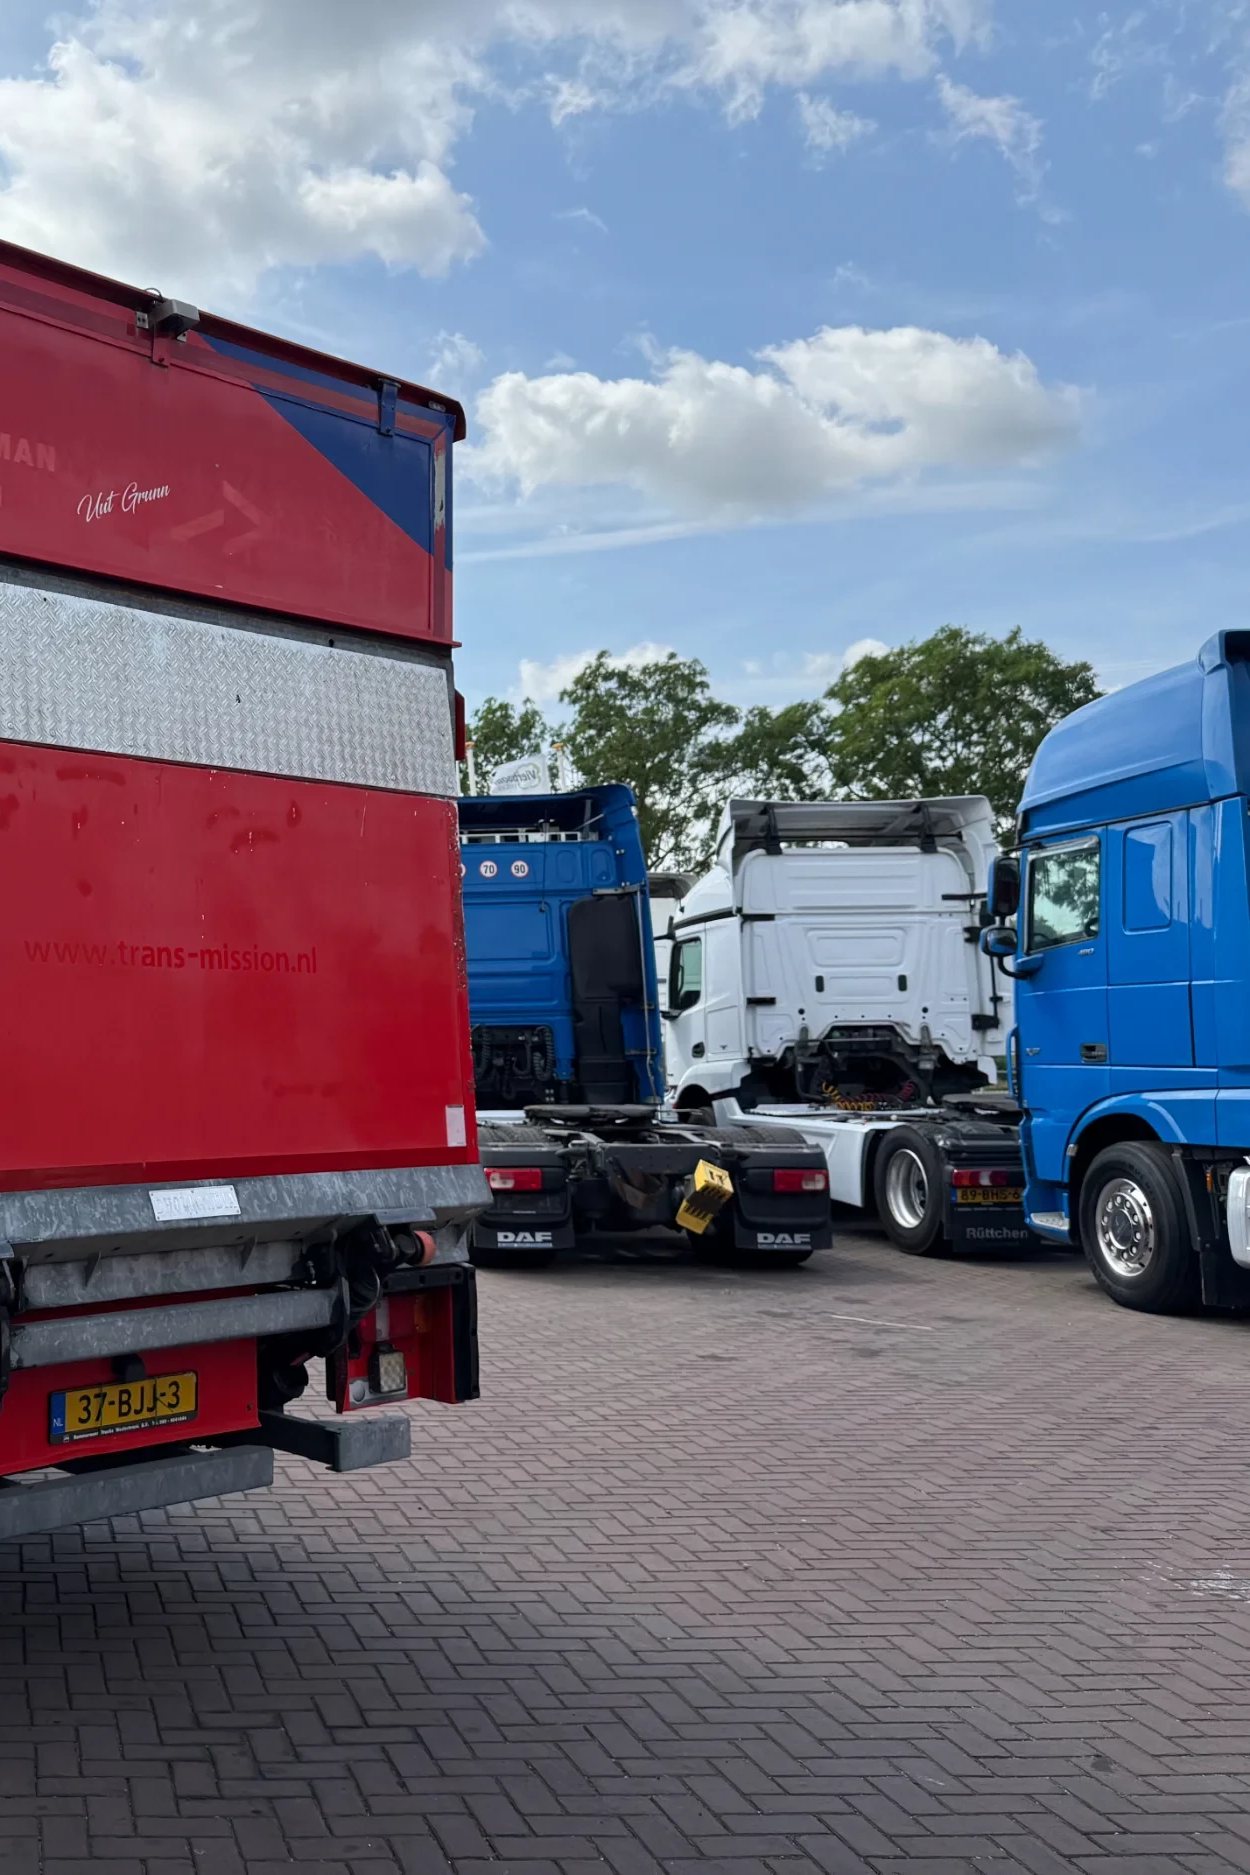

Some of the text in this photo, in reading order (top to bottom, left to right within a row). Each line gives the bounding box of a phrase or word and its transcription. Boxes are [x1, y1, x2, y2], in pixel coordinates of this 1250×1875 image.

[483, 864, 495, 874] 70
[514, 864, 526, 874] 90
[23, 939, 318, 975] www.trans-mission.nl
[496, 1231, 552, 1243] DAF
[756, 1232, 811, 1244] DAF
[965, 1226, 1029, 1239] Rüttchen
[77, 1380, 181, 1425] 37-BJJ-3
[53, 1418, 64, 1428] NL
